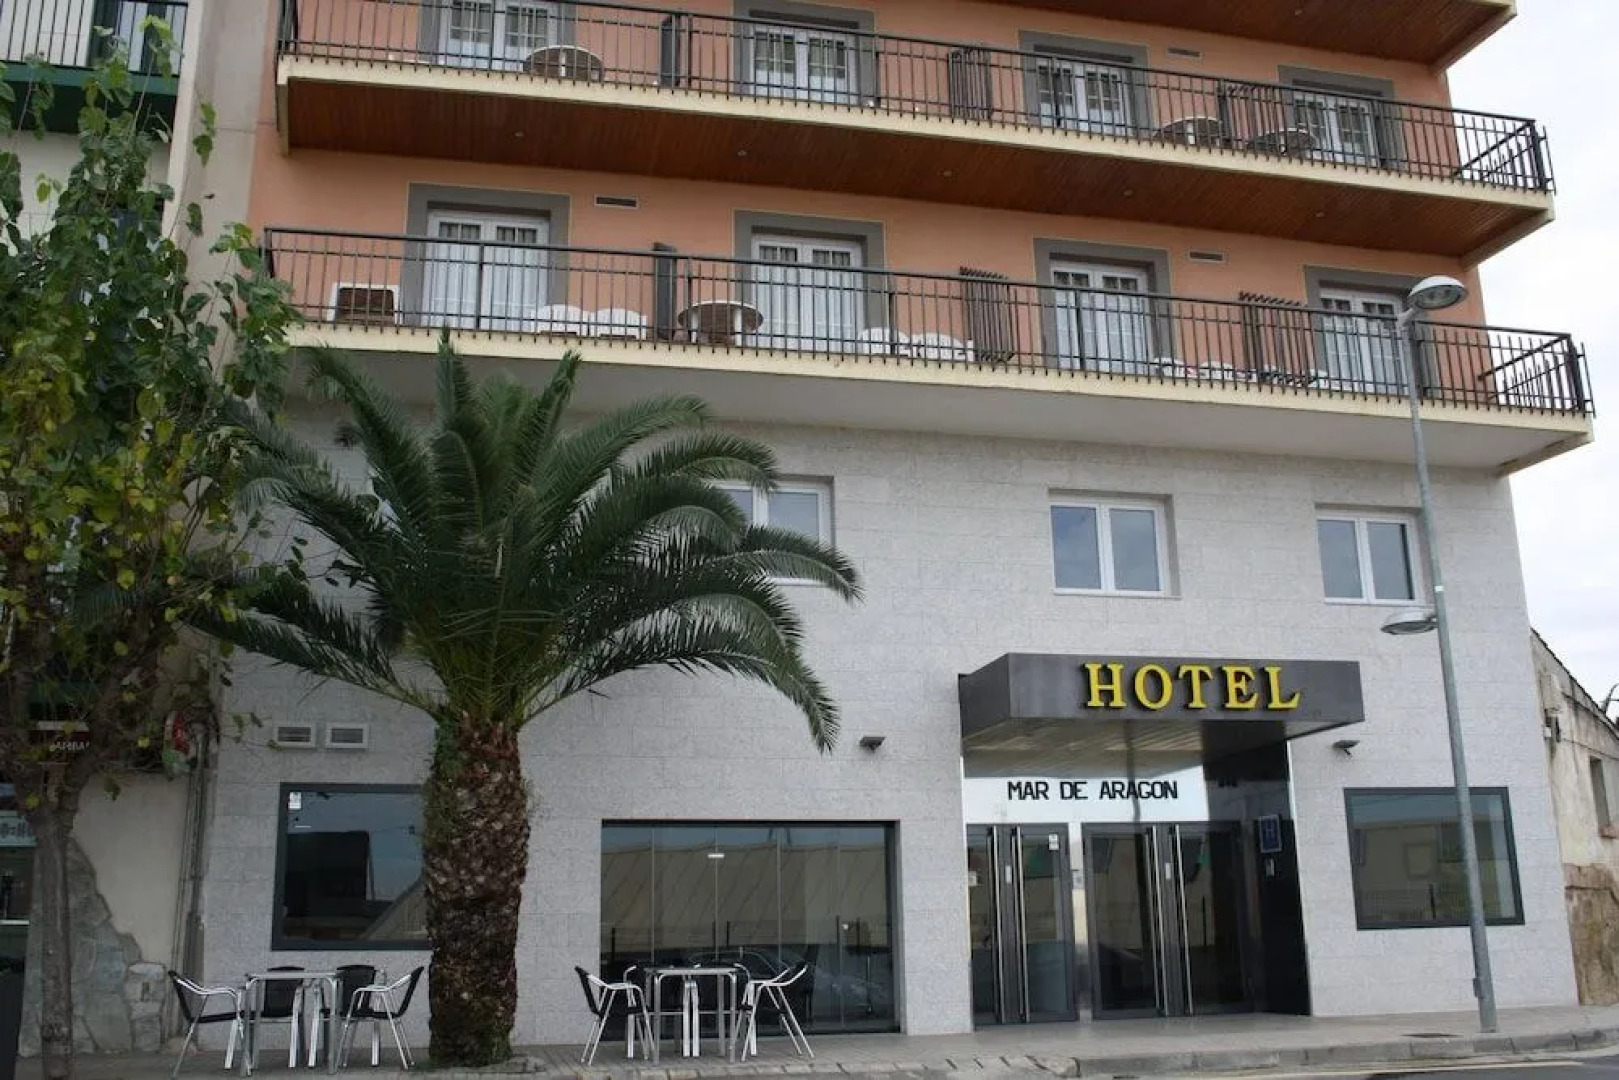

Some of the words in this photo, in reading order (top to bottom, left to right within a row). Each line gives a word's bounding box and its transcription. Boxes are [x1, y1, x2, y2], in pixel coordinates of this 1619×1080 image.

[1083, 662, 1300, 710] HOTEL
[1007, 780, 1049, 800] MAR
[1059, 780, 1088, 800] DE
[1099, 780, 1178, 800] ARAGON
